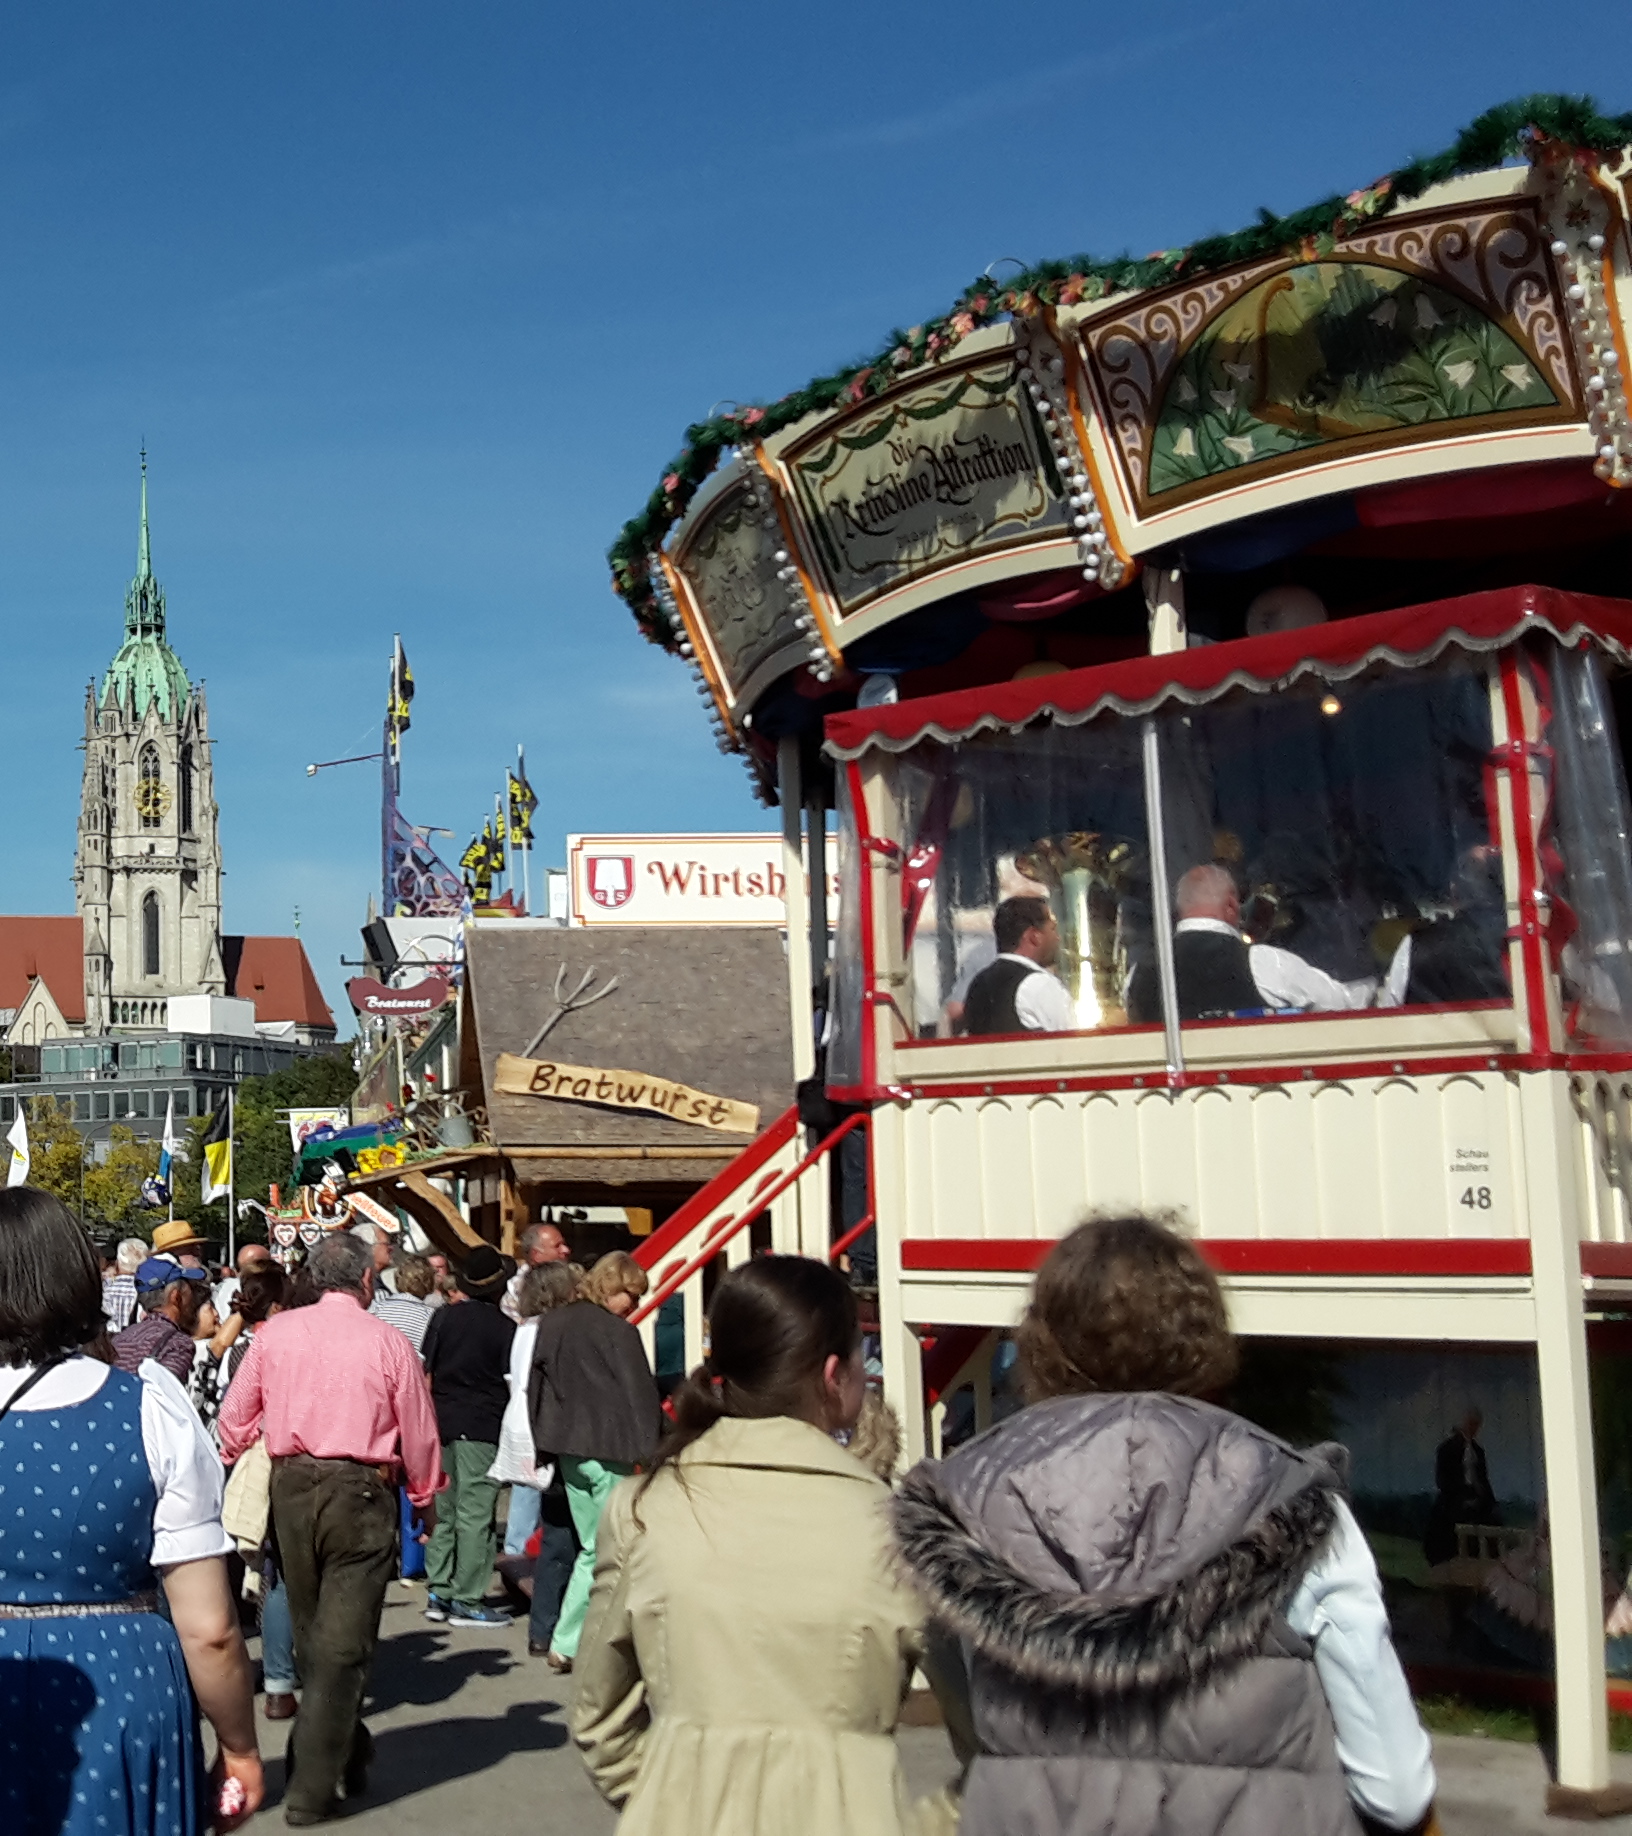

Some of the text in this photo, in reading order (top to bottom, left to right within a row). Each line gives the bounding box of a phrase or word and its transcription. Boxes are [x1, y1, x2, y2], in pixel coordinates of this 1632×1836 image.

[364, 995, 432, 1008] Bratwurst
[528, 1063, 733, 1125] Bratwurst
[1459, 1185, 1492, 1210] 48
